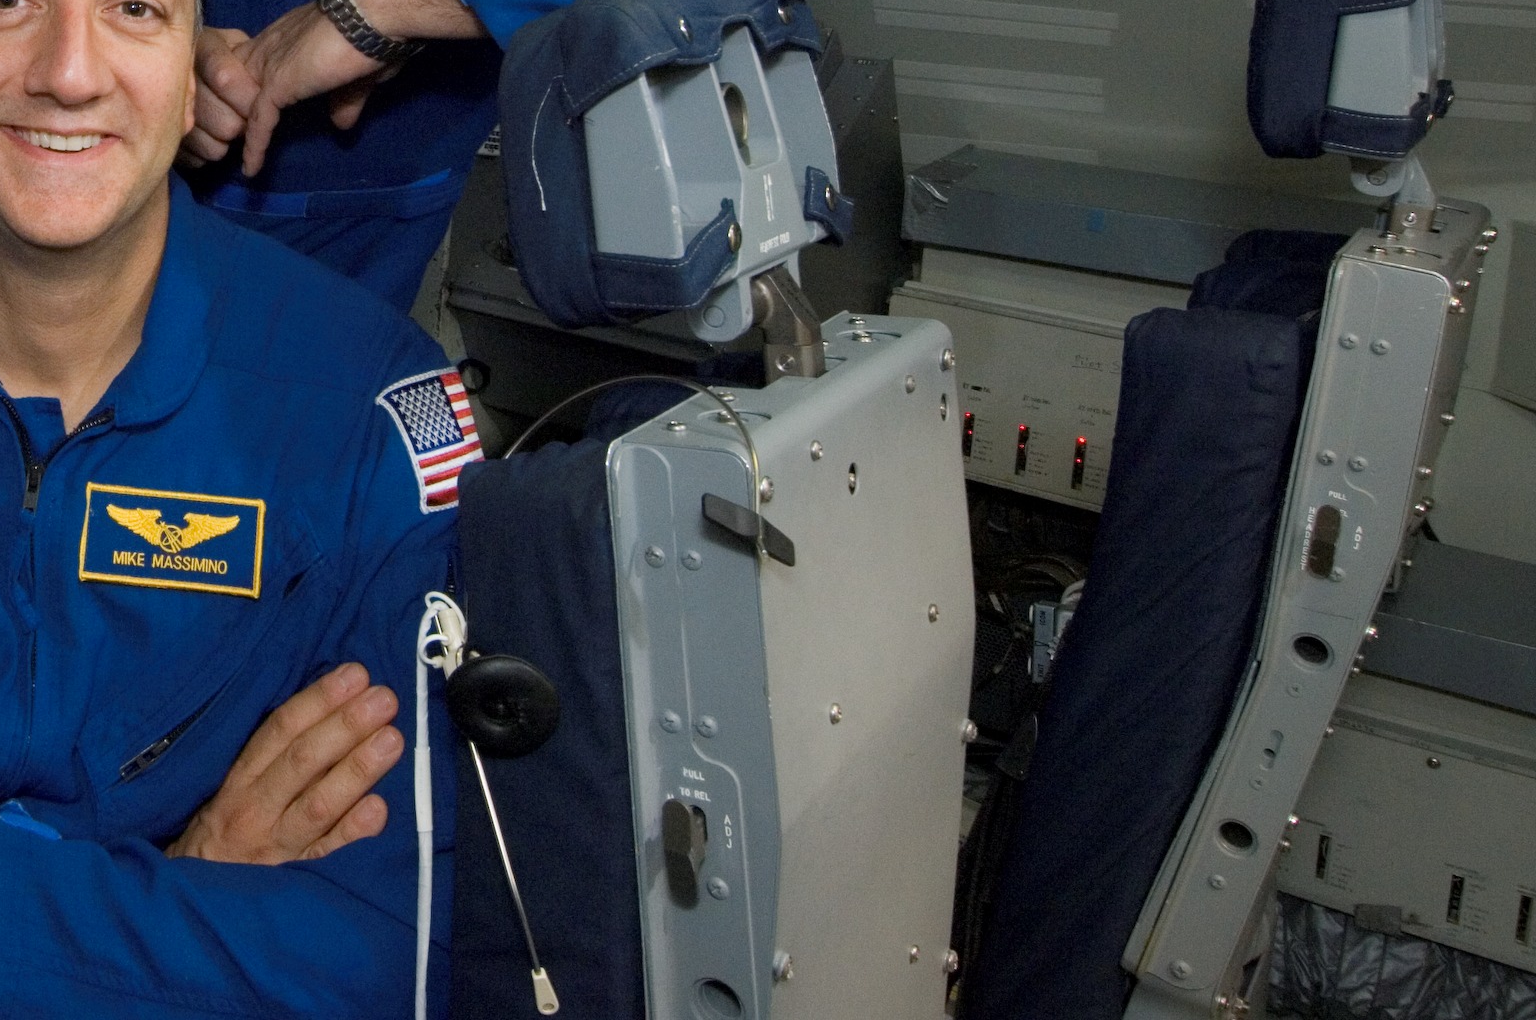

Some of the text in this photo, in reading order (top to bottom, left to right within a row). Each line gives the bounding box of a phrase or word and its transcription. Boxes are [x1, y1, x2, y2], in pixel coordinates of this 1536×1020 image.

[1328, 491, 1347, 501] PULL
[1300, 507, 1315, 570] HEADREST
[1353, 526, 1362, 549] ADJ
[113, 551, 228, 574] MIKE MASSIMINO
[683, 767, 705, 781] PULL
[679, 786, 711, 802] TO REL
